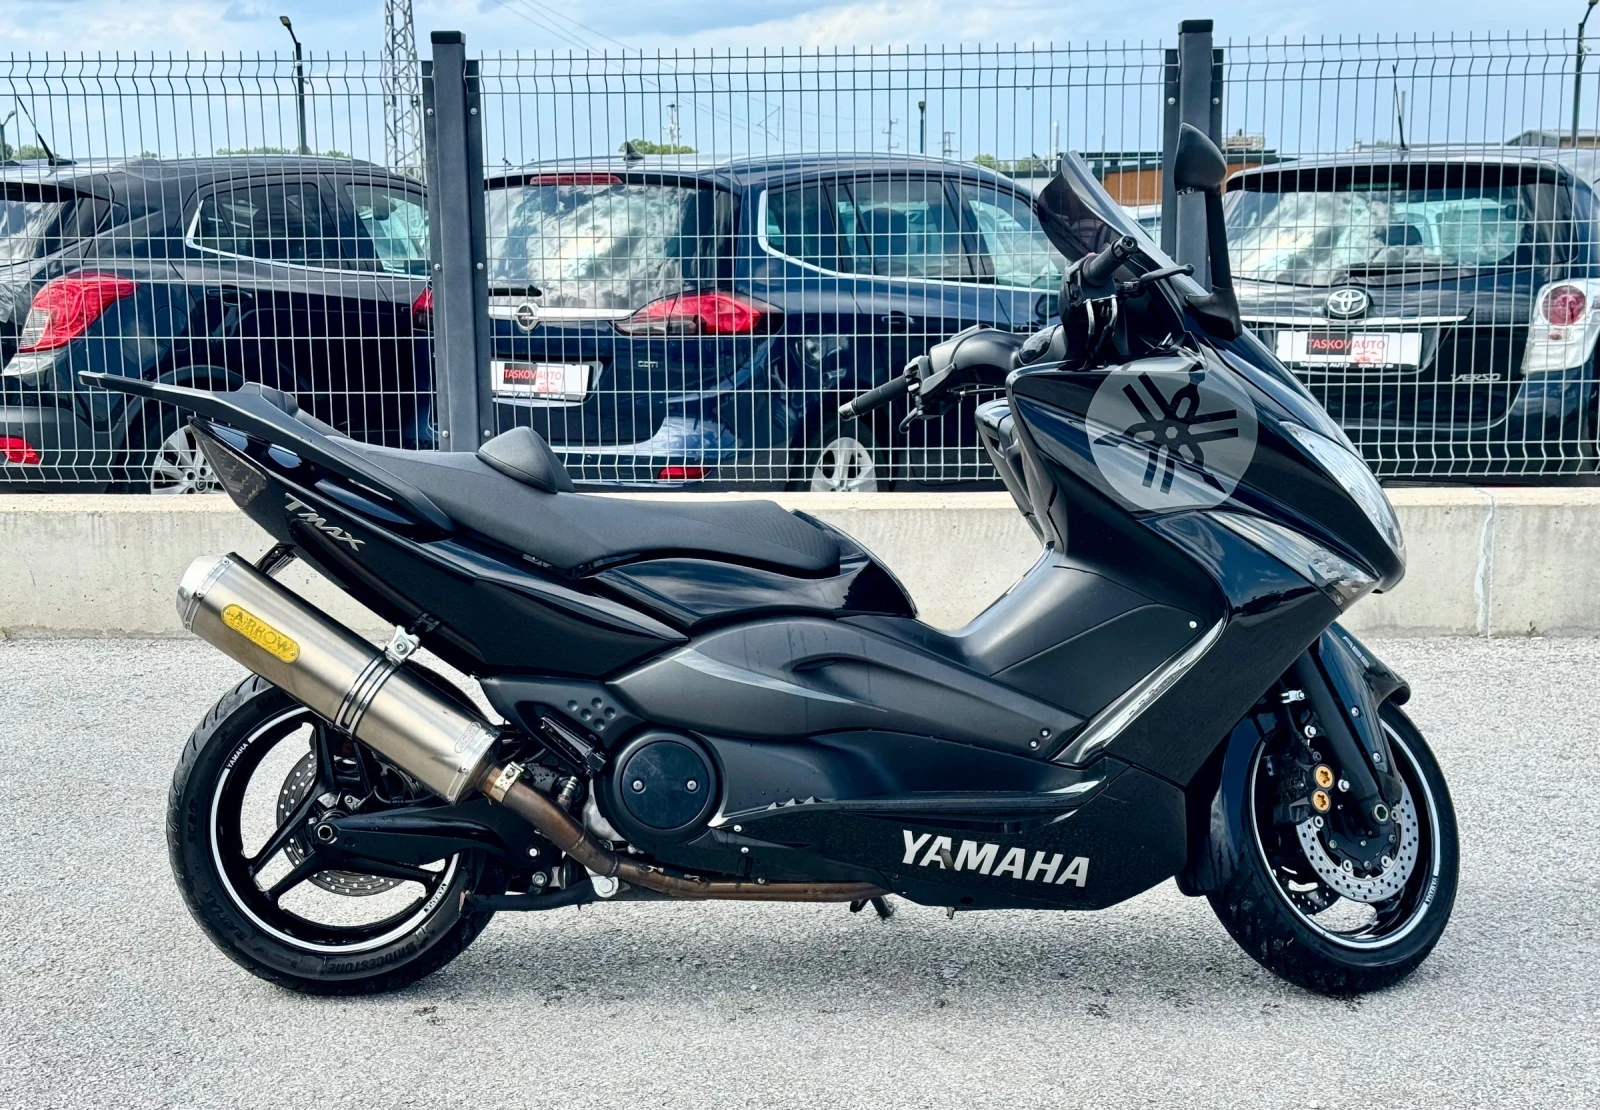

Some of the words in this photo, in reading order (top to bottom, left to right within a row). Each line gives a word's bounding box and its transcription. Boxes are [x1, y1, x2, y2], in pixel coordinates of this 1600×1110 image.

[1450, 372, 1502, 382] VERSO
[232, 610, 293, 653] ARROW
[226, 742, 250, 768] YAMAHA
[901, 828, 1091, 888] YAMAHA
[326, 940, 419, 975] BRIDGESTONE
